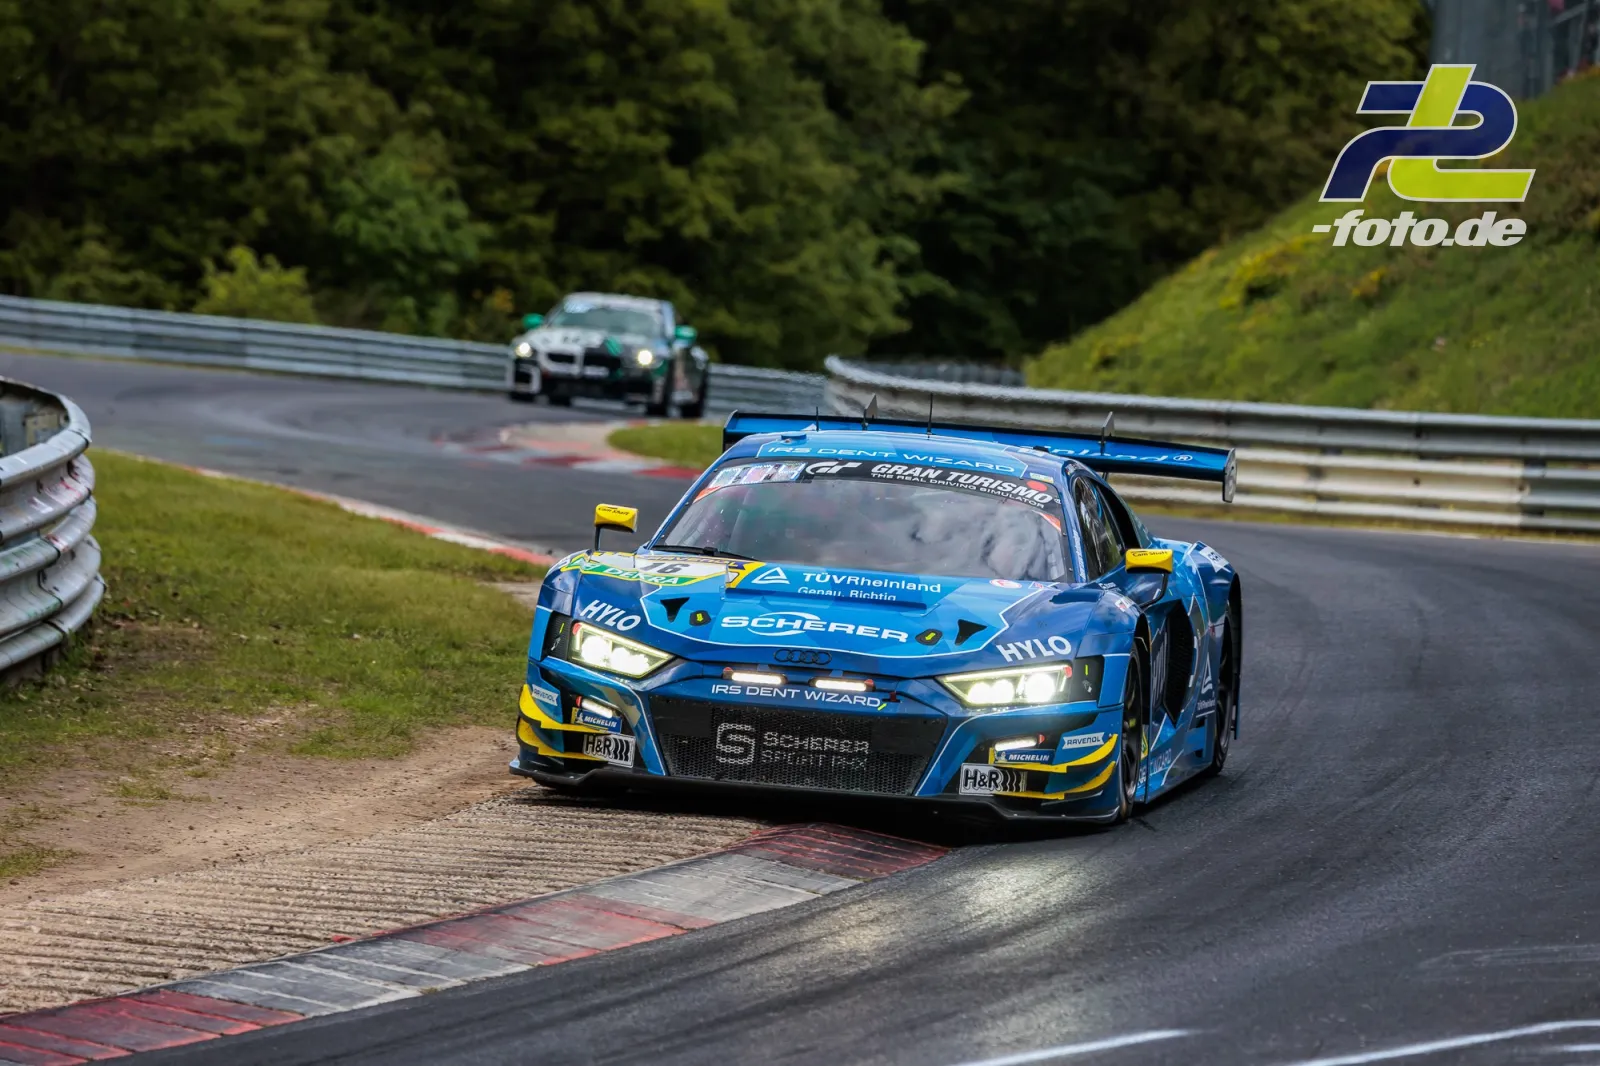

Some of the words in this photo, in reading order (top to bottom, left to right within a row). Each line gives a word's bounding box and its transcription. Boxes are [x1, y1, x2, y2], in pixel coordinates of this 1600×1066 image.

[817, 448, 897, 458] DENT
[903, 453, 1015, 473] WIZARD
[871, 463, 944, 479] GRAN
[871, 472, 894, 480] THE
[895, 474, 926, 484] REAL
[930, 479, 977, 491] DRIVING
[979, 487, 1045, 509] SIMULATOR
[603, 567, 679, 585] DEKRA
[802, 572, 941, 593] TÜVRheinland
[580, 599, 642, 632] HYLO
[721, 615, 909, 643] SCHERER
[996, 635, 1072, 664] HYLO
[711, 684, 742, 695] IRS
[745, 686, 801, 699] DENT
[804, 690, 881, 708] WIZARD
[584, 715, 618, 729] MICHELIN
[585, 734, 612, 758] H&R
[1066, 735, 1101, 747] RAVENOL
[1008, 753, 1050, 762] MICHELIN
[963, 768, 1001, 791] H&R
